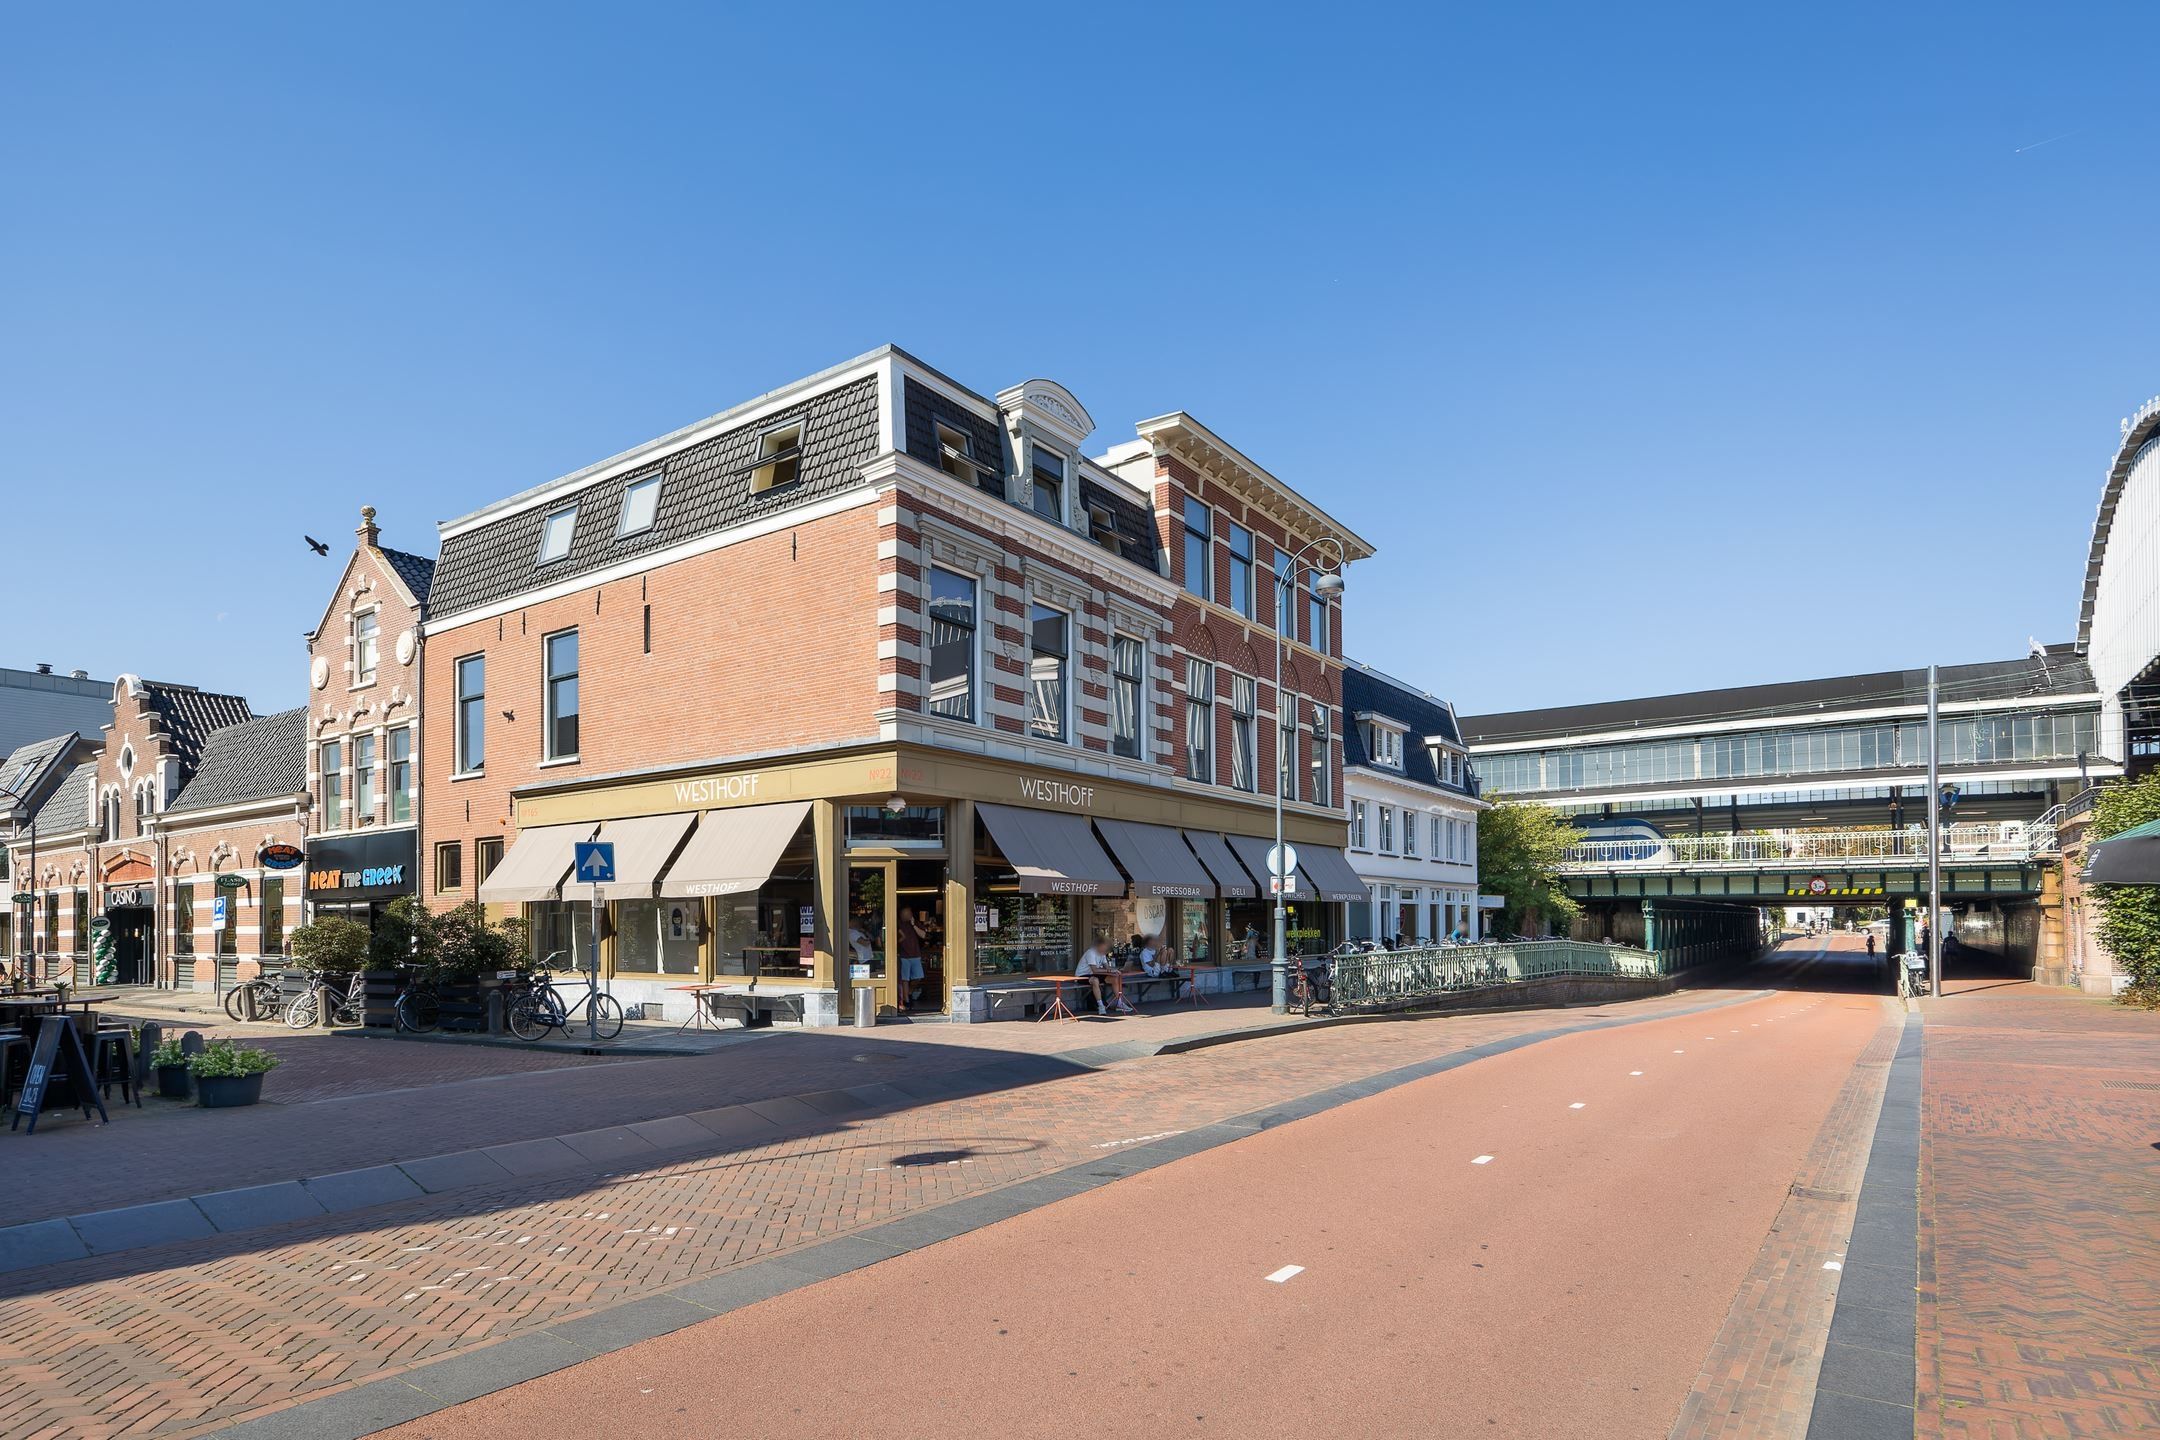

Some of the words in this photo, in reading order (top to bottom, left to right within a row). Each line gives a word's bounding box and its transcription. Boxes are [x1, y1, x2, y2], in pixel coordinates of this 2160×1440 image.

[673, 774, 760, 804] WESTHOFF
[1019, 776, 1094, 808] WESTHOFF
[686, 881, 741, 895] WESTHOFF
[1051, 881, 1099, 893] WESTHOFF
[1152, 885, 1201, 896] ESPRESSOBAR
[1232, 887, 1246, 896] DELI
[110, 889, 137, 906] CASINO
[1332, 893, 1362, 901] WERKPLEKKEN
[216, 899, 223, 912] P
